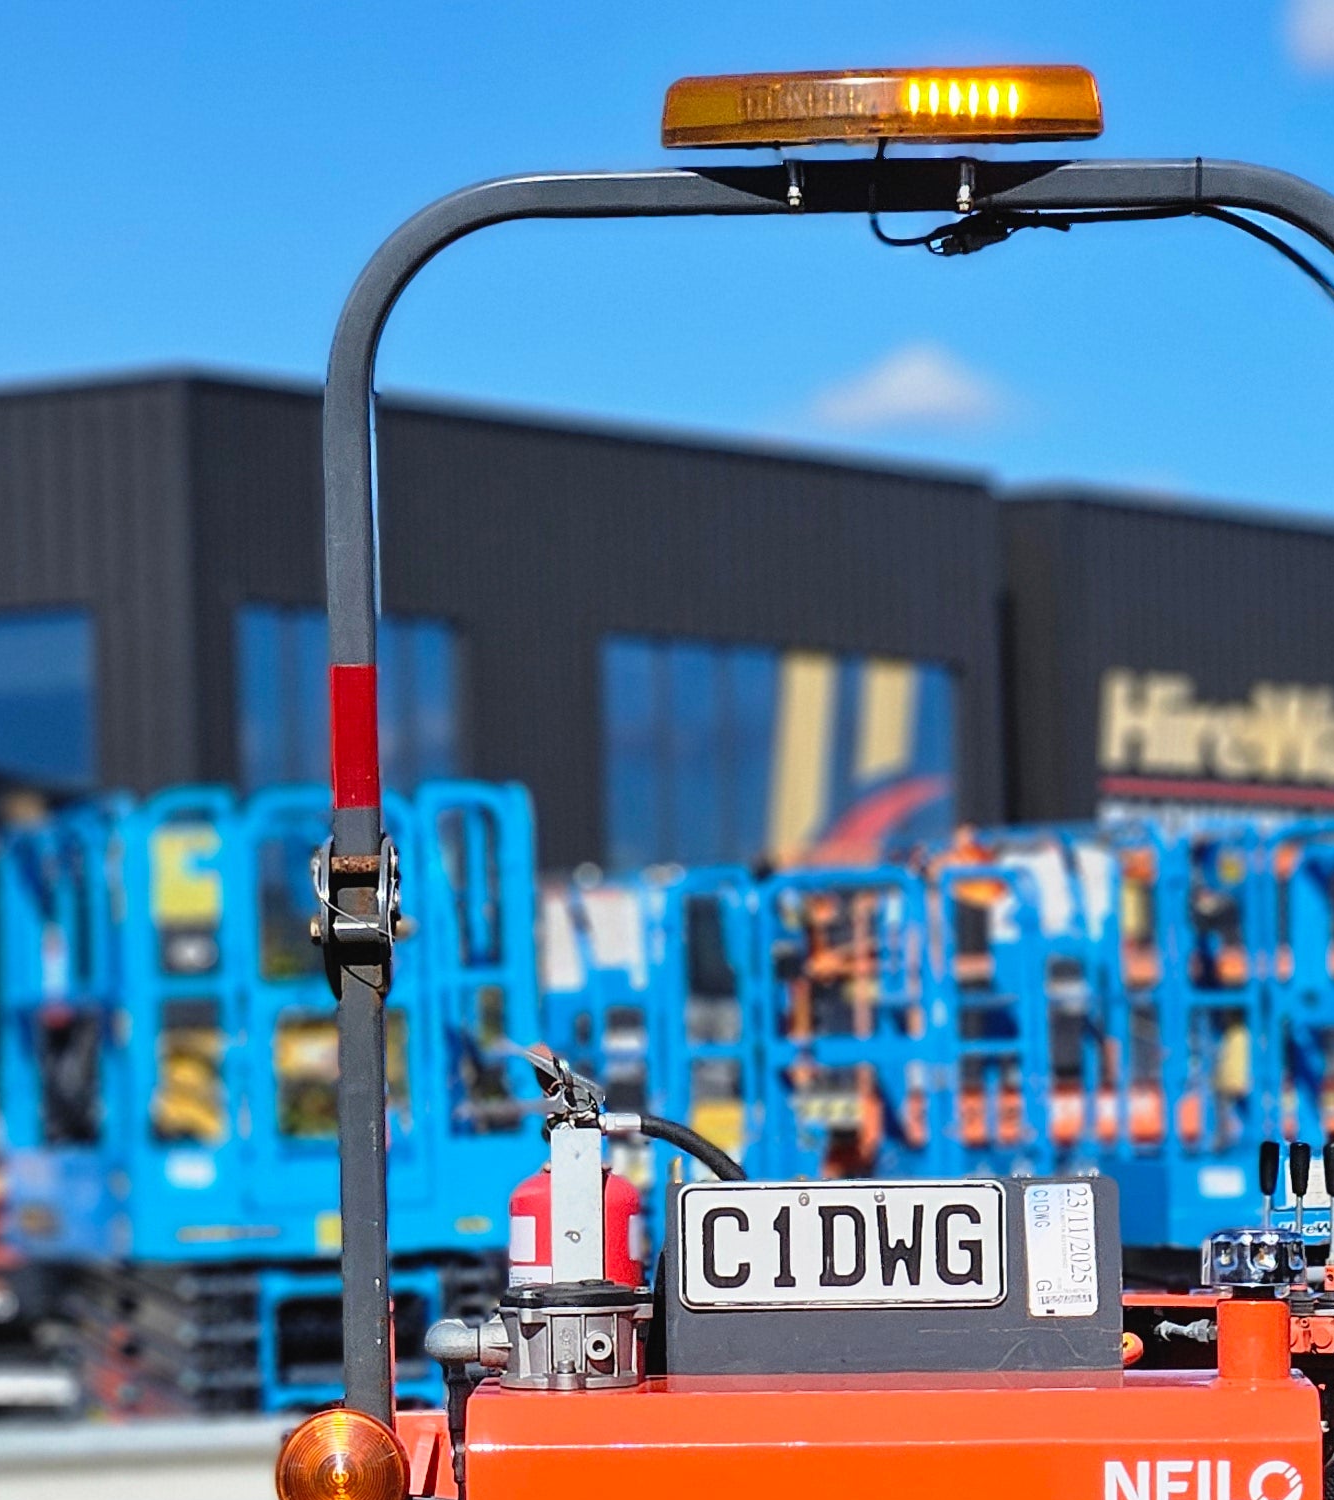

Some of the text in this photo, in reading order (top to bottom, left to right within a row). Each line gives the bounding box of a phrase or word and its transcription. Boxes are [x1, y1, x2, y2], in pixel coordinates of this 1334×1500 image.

[702, 1203, 984, 1288] C1DWG
[1033, 1190, 1051, 1228] C1DWG
[1067, 1187, 1092, 1283] 23/11/2025
